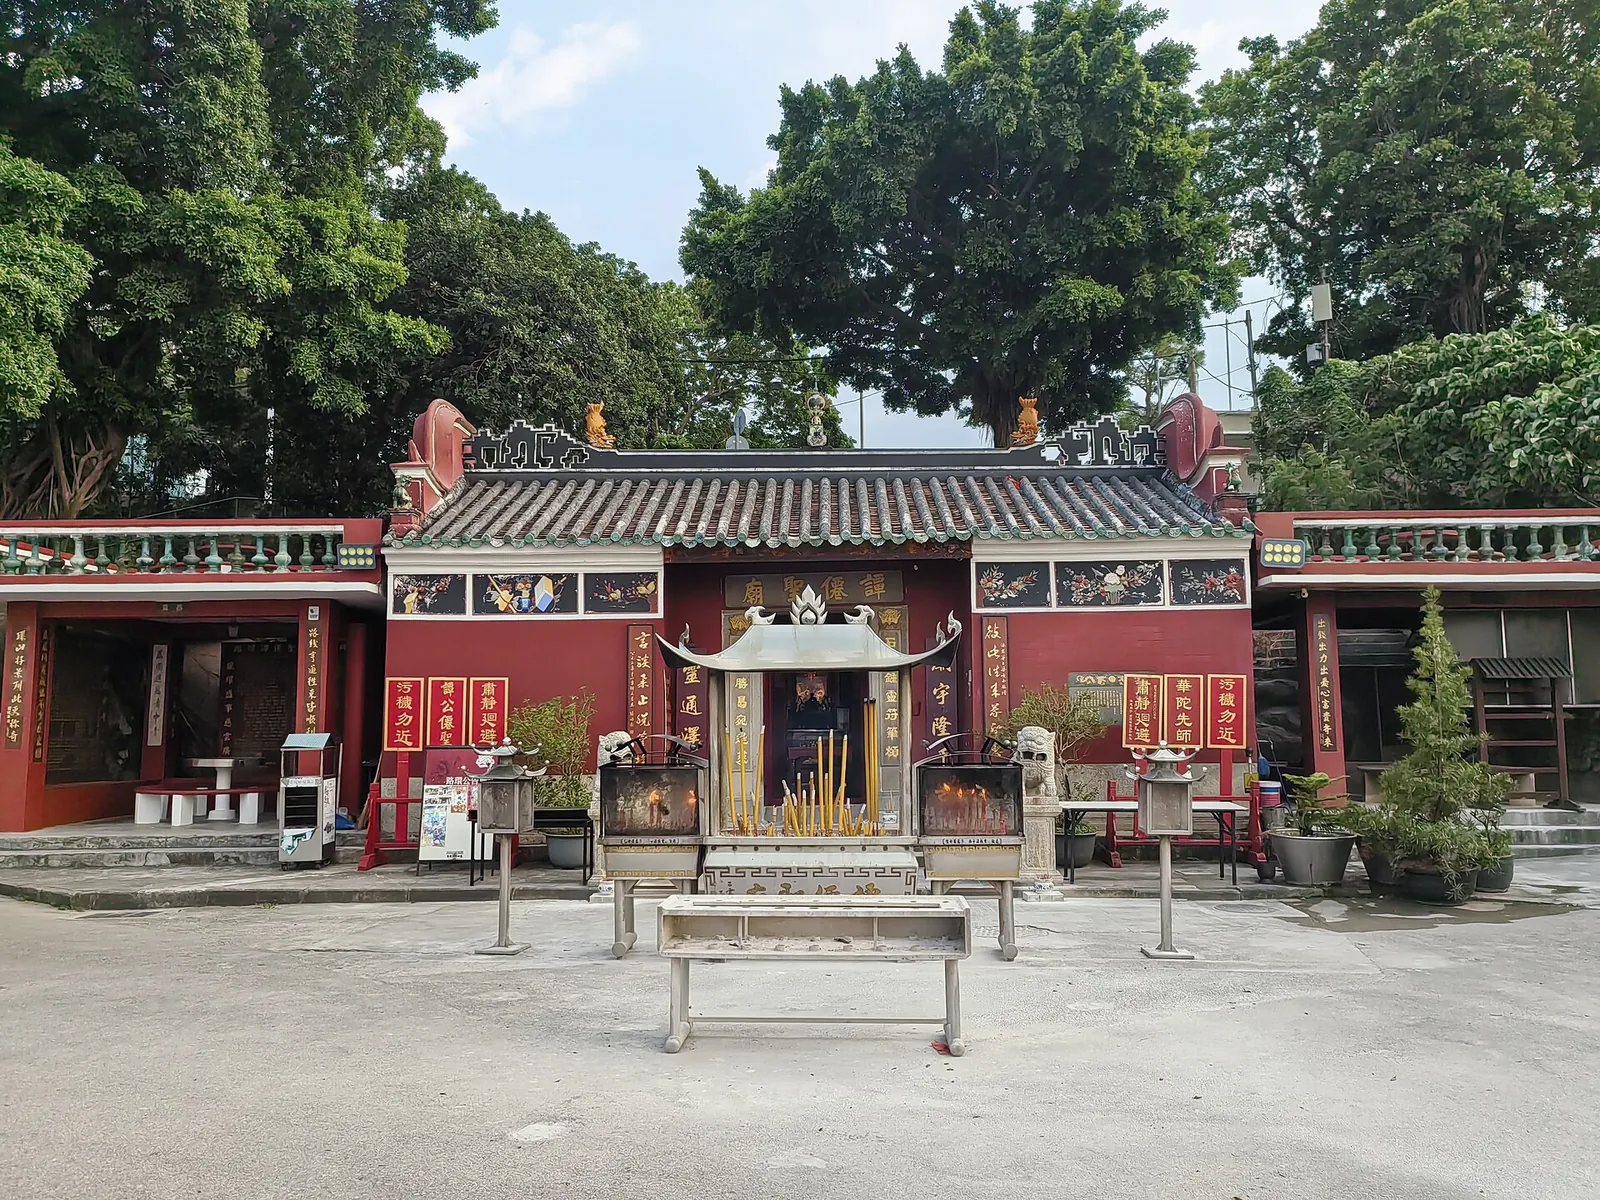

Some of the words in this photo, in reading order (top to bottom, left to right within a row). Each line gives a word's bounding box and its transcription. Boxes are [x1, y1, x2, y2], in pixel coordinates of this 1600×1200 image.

[393, 681, 413, 747] 污穢勿近
[1175, 679, 1193, 743] 華陀先師
[1216, 678, 1237, 744] 污穢勿近
